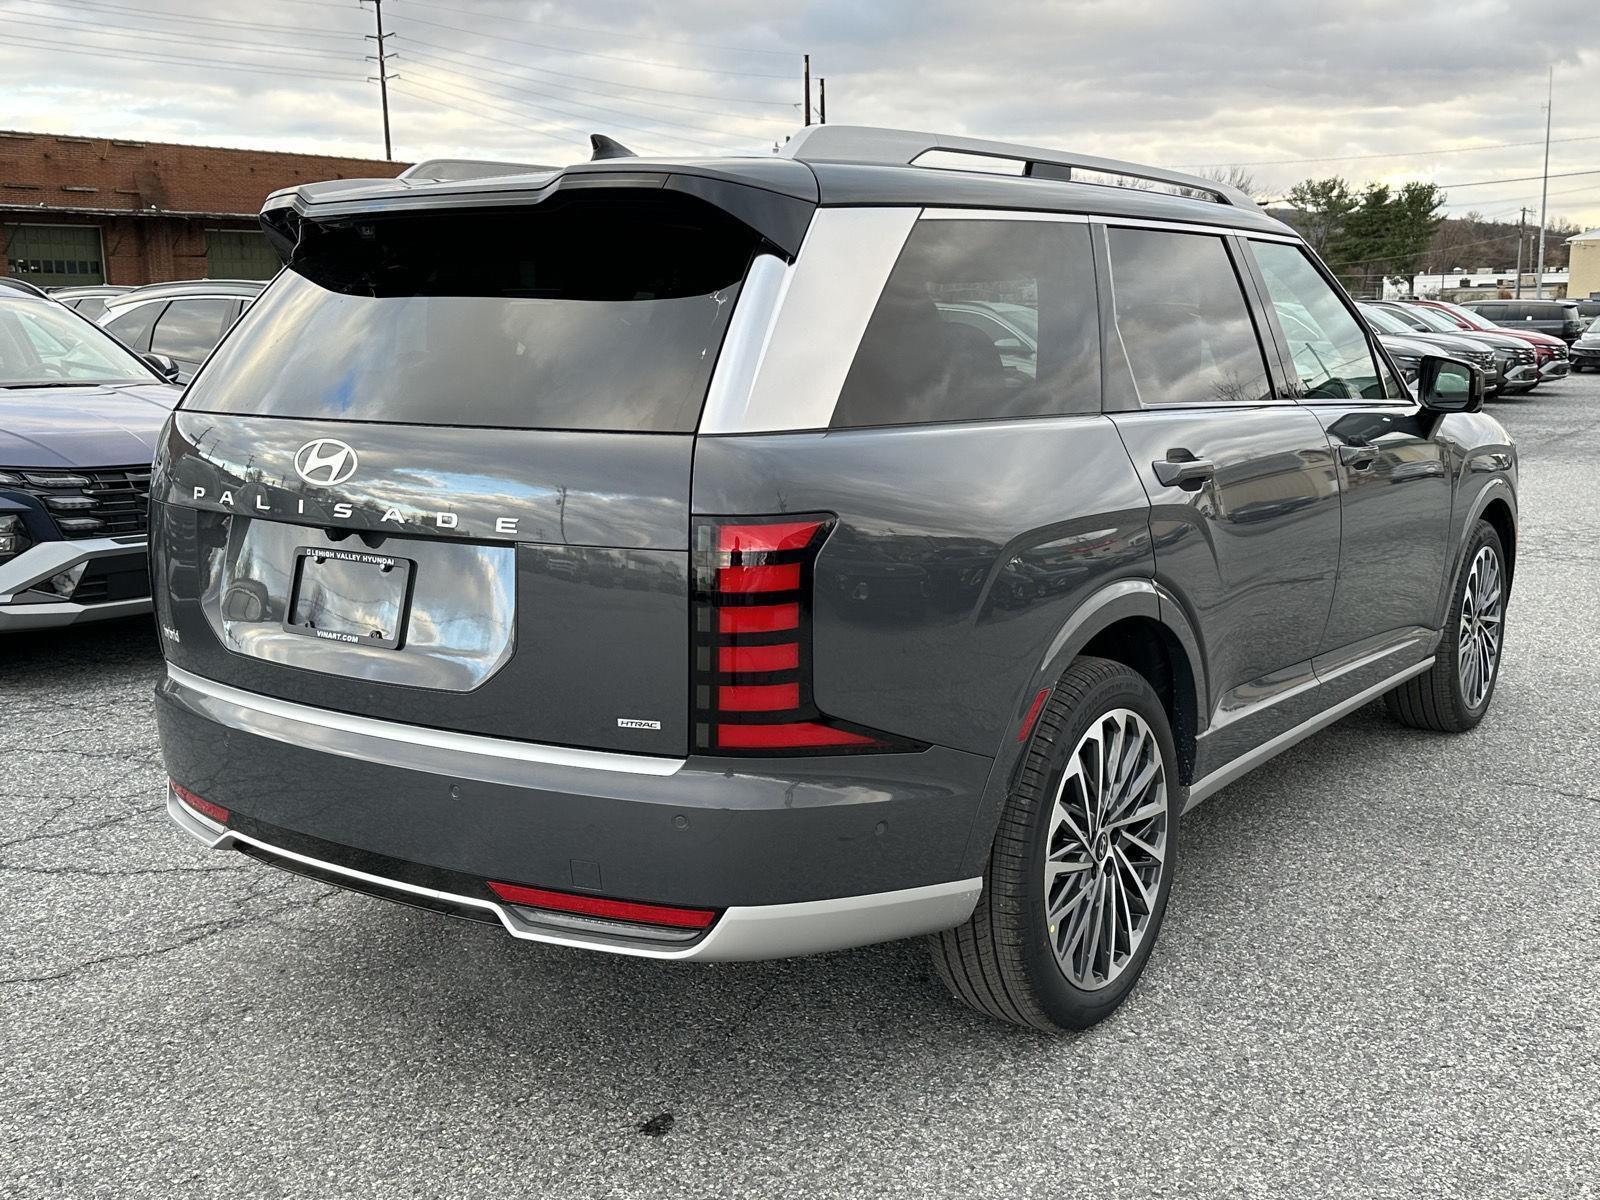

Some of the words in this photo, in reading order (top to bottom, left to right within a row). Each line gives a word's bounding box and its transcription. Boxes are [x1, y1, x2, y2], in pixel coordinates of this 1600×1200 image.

[193, 486, 520, 534] PALISADE
[311, 549, 335, 558] LEHIGH
[336, 552, 361, 561] VALLEY
[362, 555, 395, 565] HYUNDAI
[316, 630, 359, 643] VINART.COM
[619, 720, 659, 729] HTRAC
